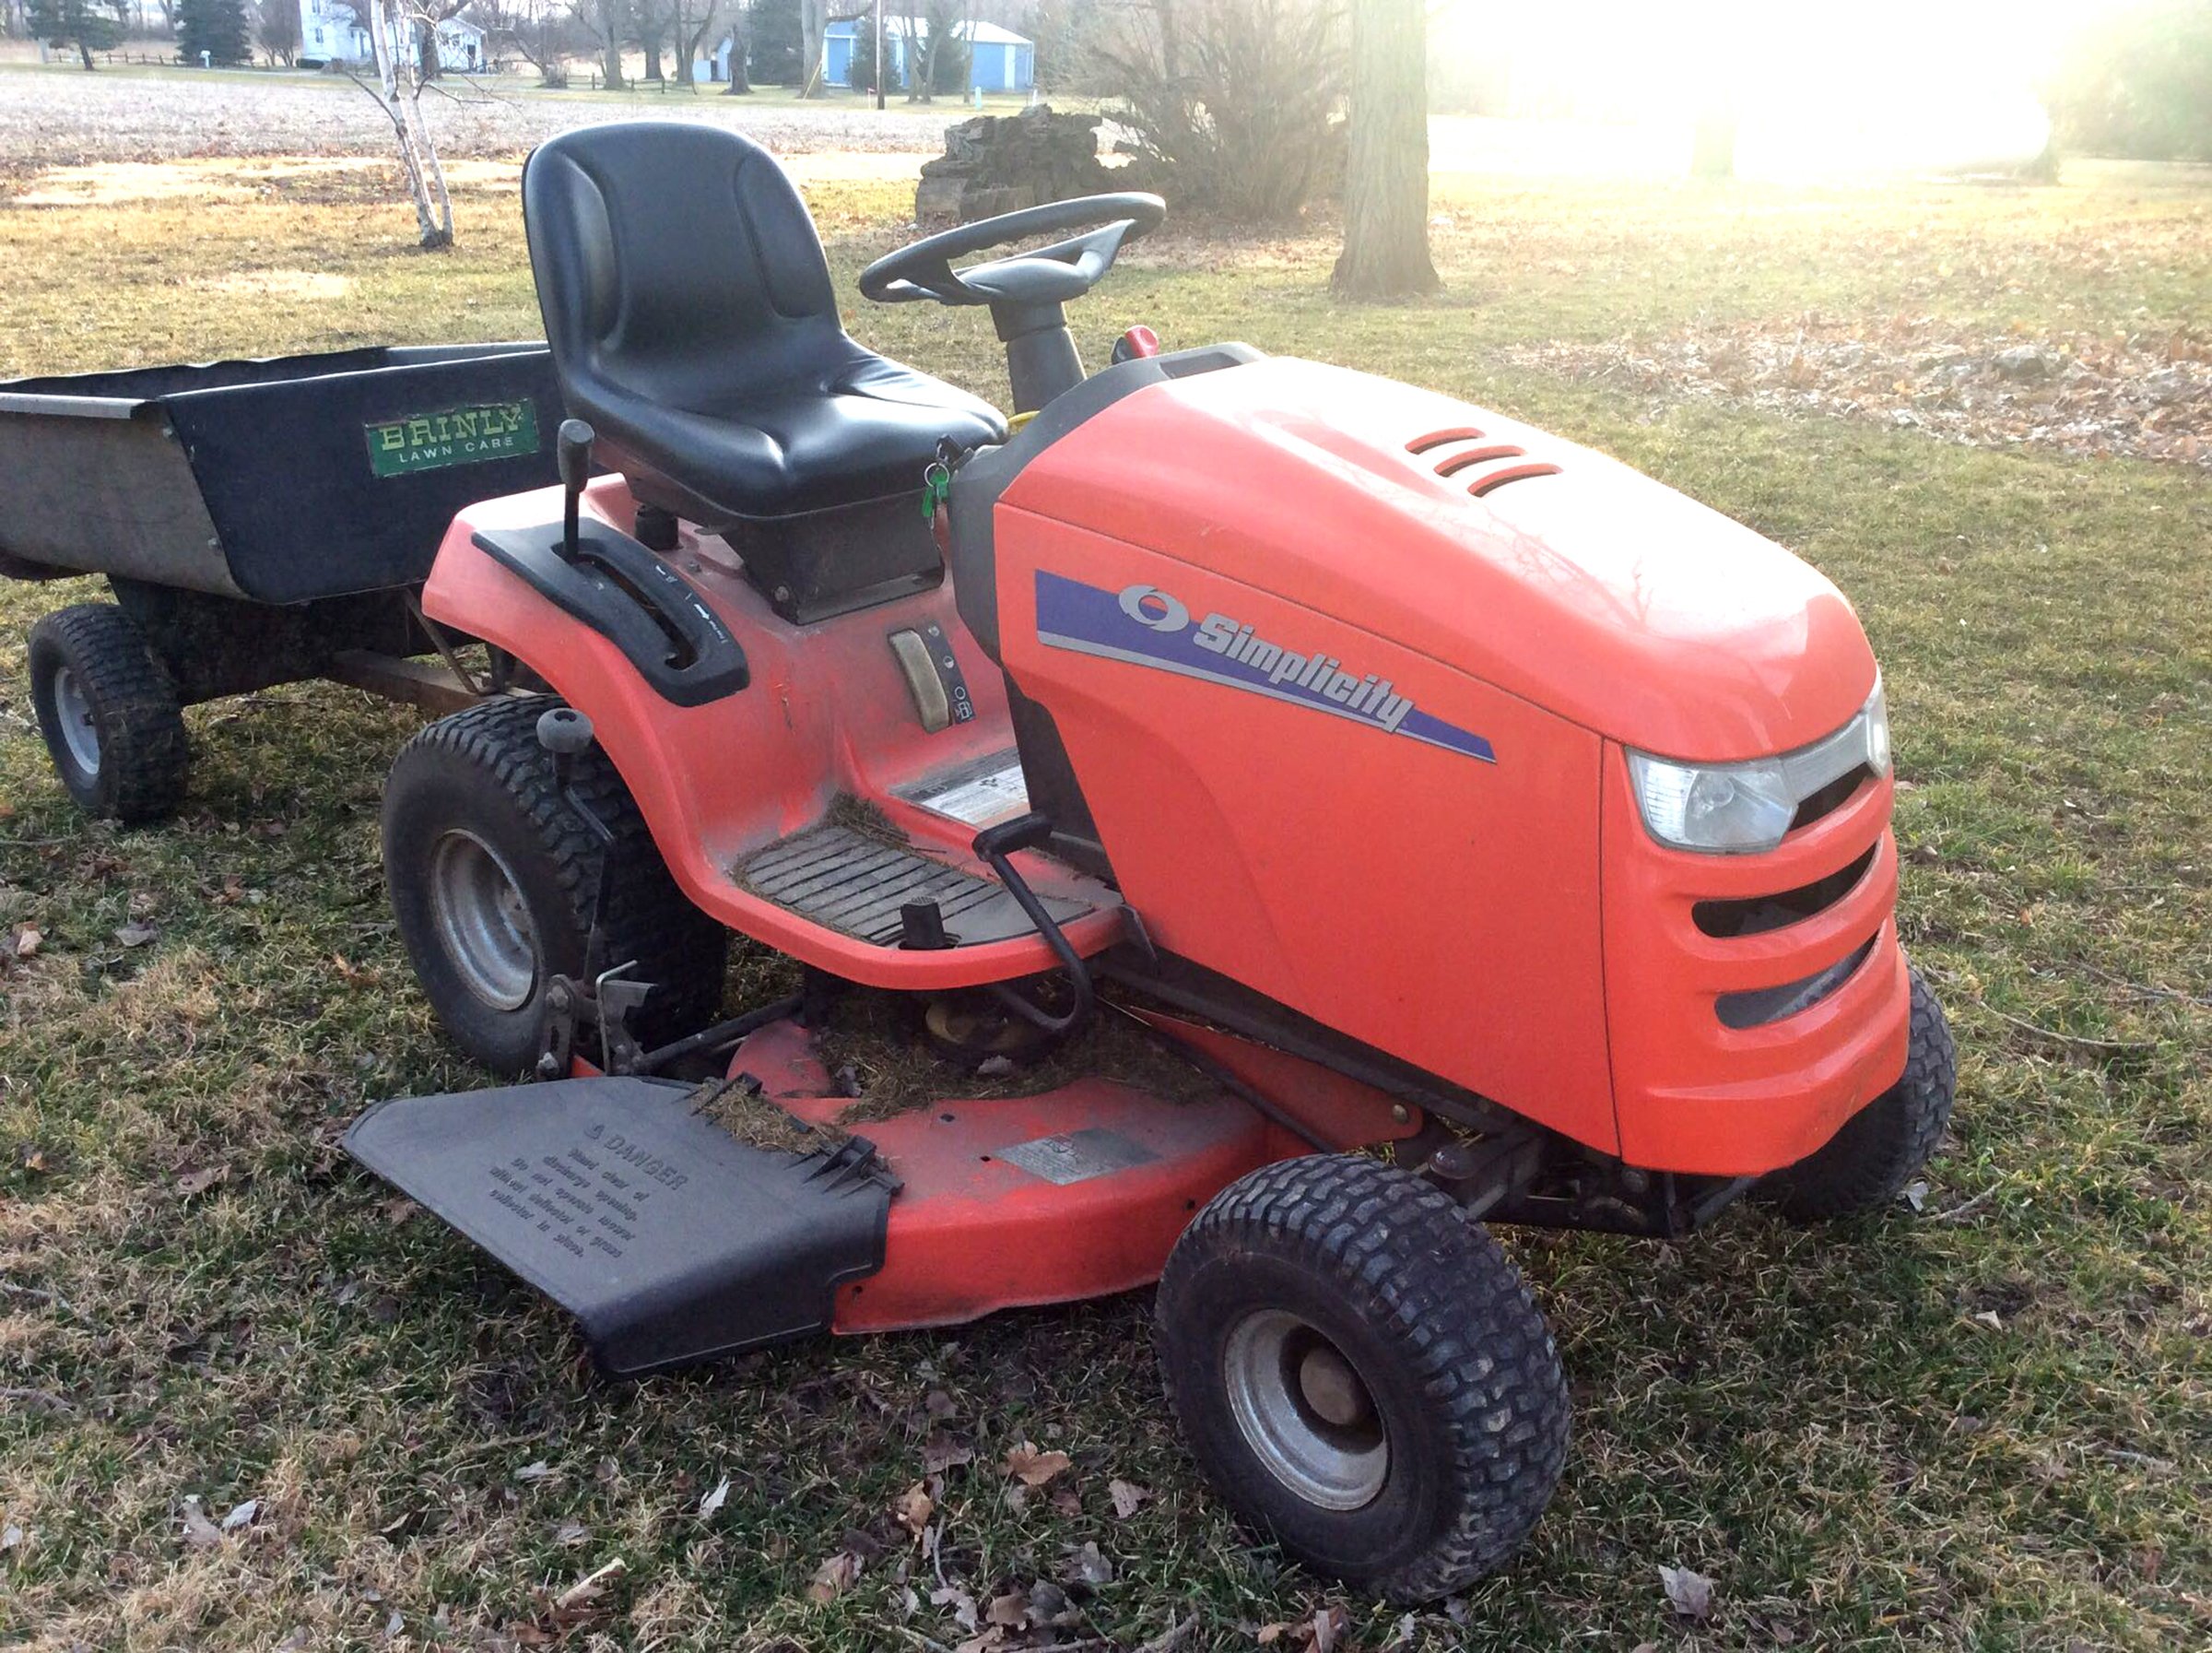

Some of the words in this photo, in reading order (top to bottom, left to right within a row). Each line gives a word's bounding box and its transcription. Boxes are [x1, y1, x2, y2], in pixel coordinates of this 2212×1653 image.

[379, 406, 522, 451] BRINLY
[399, 445, 453, 463] LAWN
[465, 436, 514, 453] CARE
[1193, 612, 1415, 733] Simplicity
[543, 1155, 591, 1188] discharge
[595, 1190, 638, 1222] opening.
[602, 1171, 629, 1189] clear
[633, 1191, 650, 1202] of
[604, 1135, 688, 1190] DANGER
[488, 1166, 529, 1194] without
[528, 1193, 575, 1224] deflector
[576, 1224, 592, 1236] or
[589, 1236, 623, 1258] grass
[488, 1189, 535, 1220] collector
[536, 1220, 550, 1233] in
[553, 1233, 584, 1257] place.
[511, 1158, 529, 1171] Do
[531, 1173, 553, 1187] not
[555, 1187, 594, 1214] operate
[597, 1215, 636, 1241] mower
